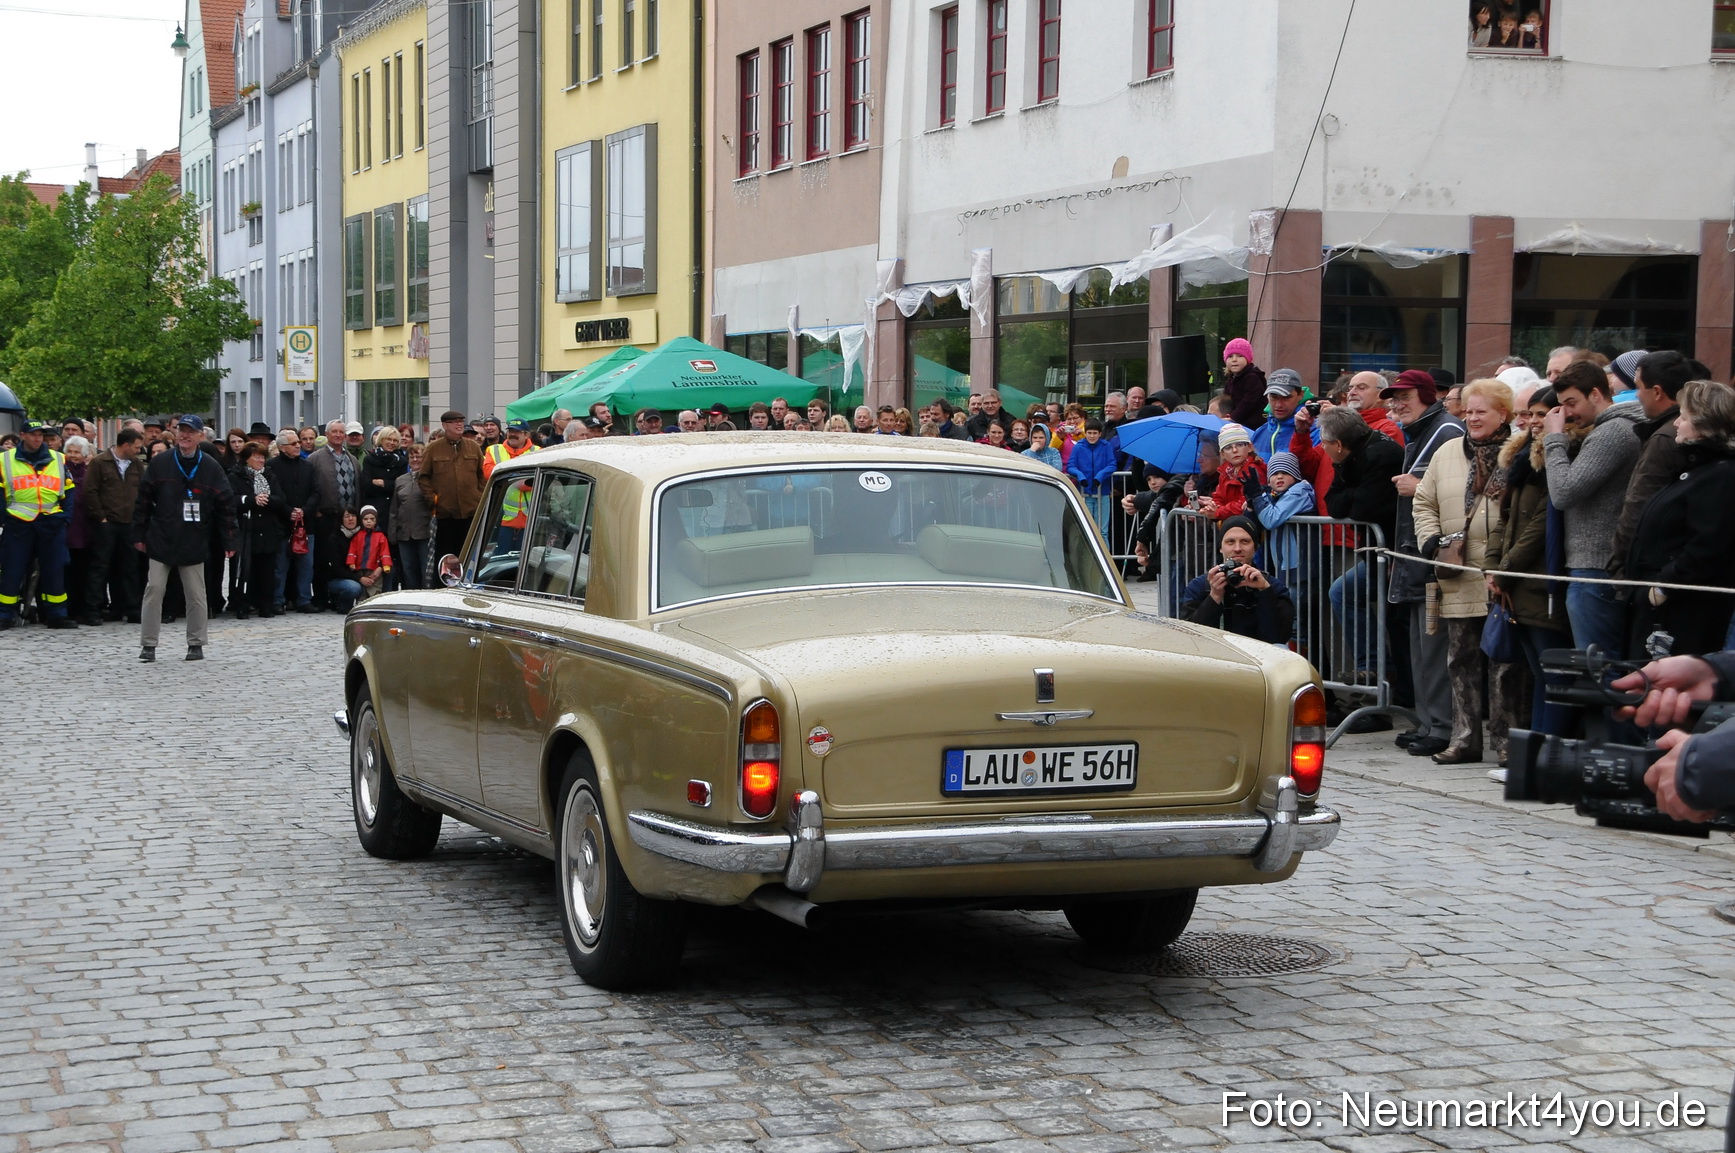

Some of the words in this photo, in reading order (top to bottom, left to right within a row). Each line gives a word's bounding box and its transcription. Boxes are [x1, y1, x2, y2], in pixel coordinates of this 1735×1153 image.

[295, 335, 306, 348] H
[671, 379, 758, 388] Lammsbräu
[12, 475, 57, 488] THW
[864, 476, 886, 485] MC
[964, 753, 1019, 785] LAU
[1041, 751, 1075, 783] WE
[1082, 749, 1133, 781] 56H
[950, 773, 958, 783] D
